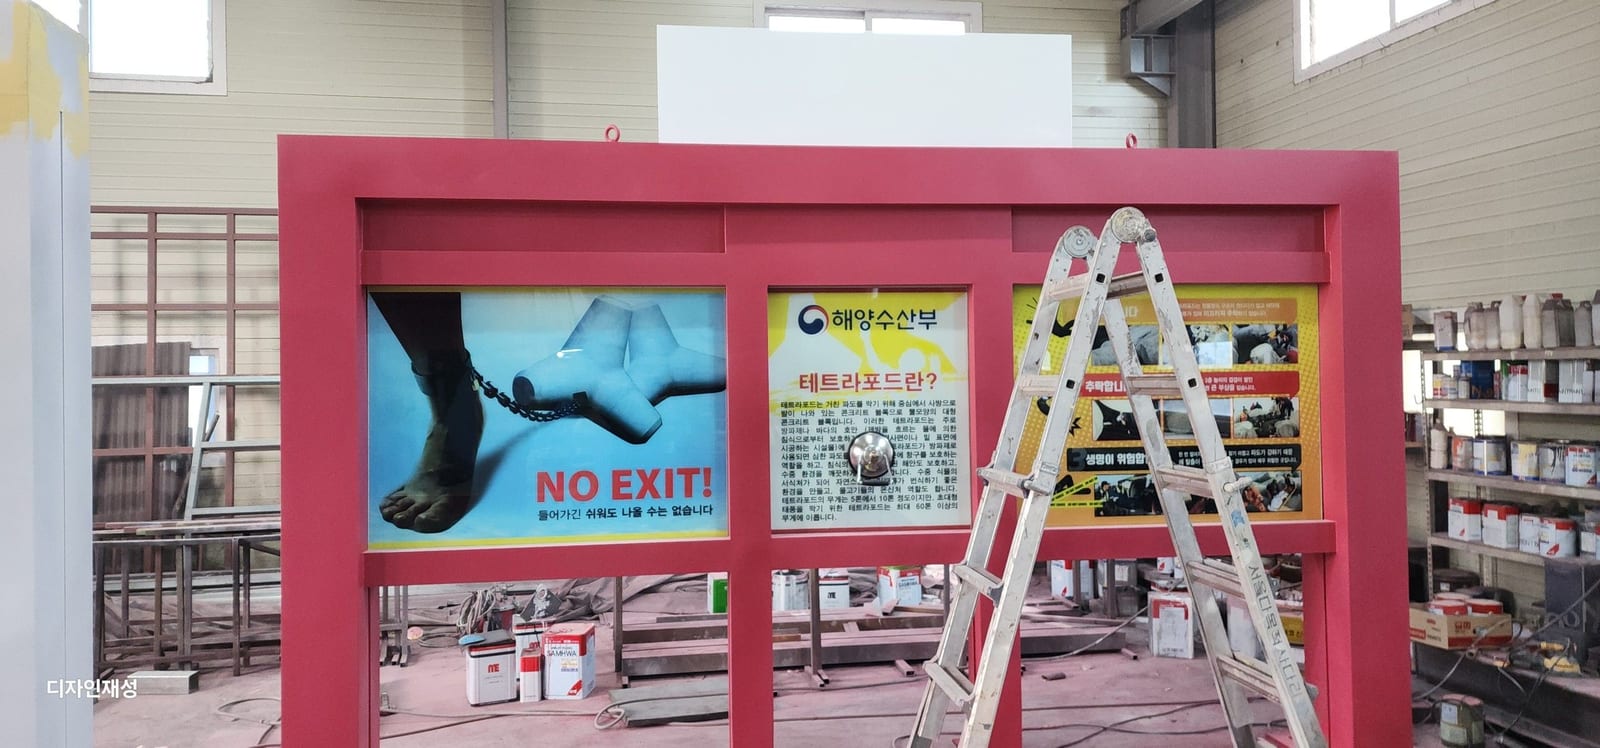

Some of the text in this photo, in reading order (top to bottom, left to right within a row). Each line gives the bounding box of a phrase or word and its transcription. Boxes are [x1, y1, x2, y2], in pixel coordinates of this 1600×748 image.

[832, 309, 937, 332] 해양수산부
[799, 372, 937, 393] 테트라포드란?
[1086, 380, 1126, 392] 추락합니
[1086, 453, 1114, 465] 생명이
[536, 467, 713, 503] NO EXIT!
[538, 504, 713, 521] 들어가긴 쉬워도 나올 수는 없습니다
[1278, 648, 1302, 700] 사다리
